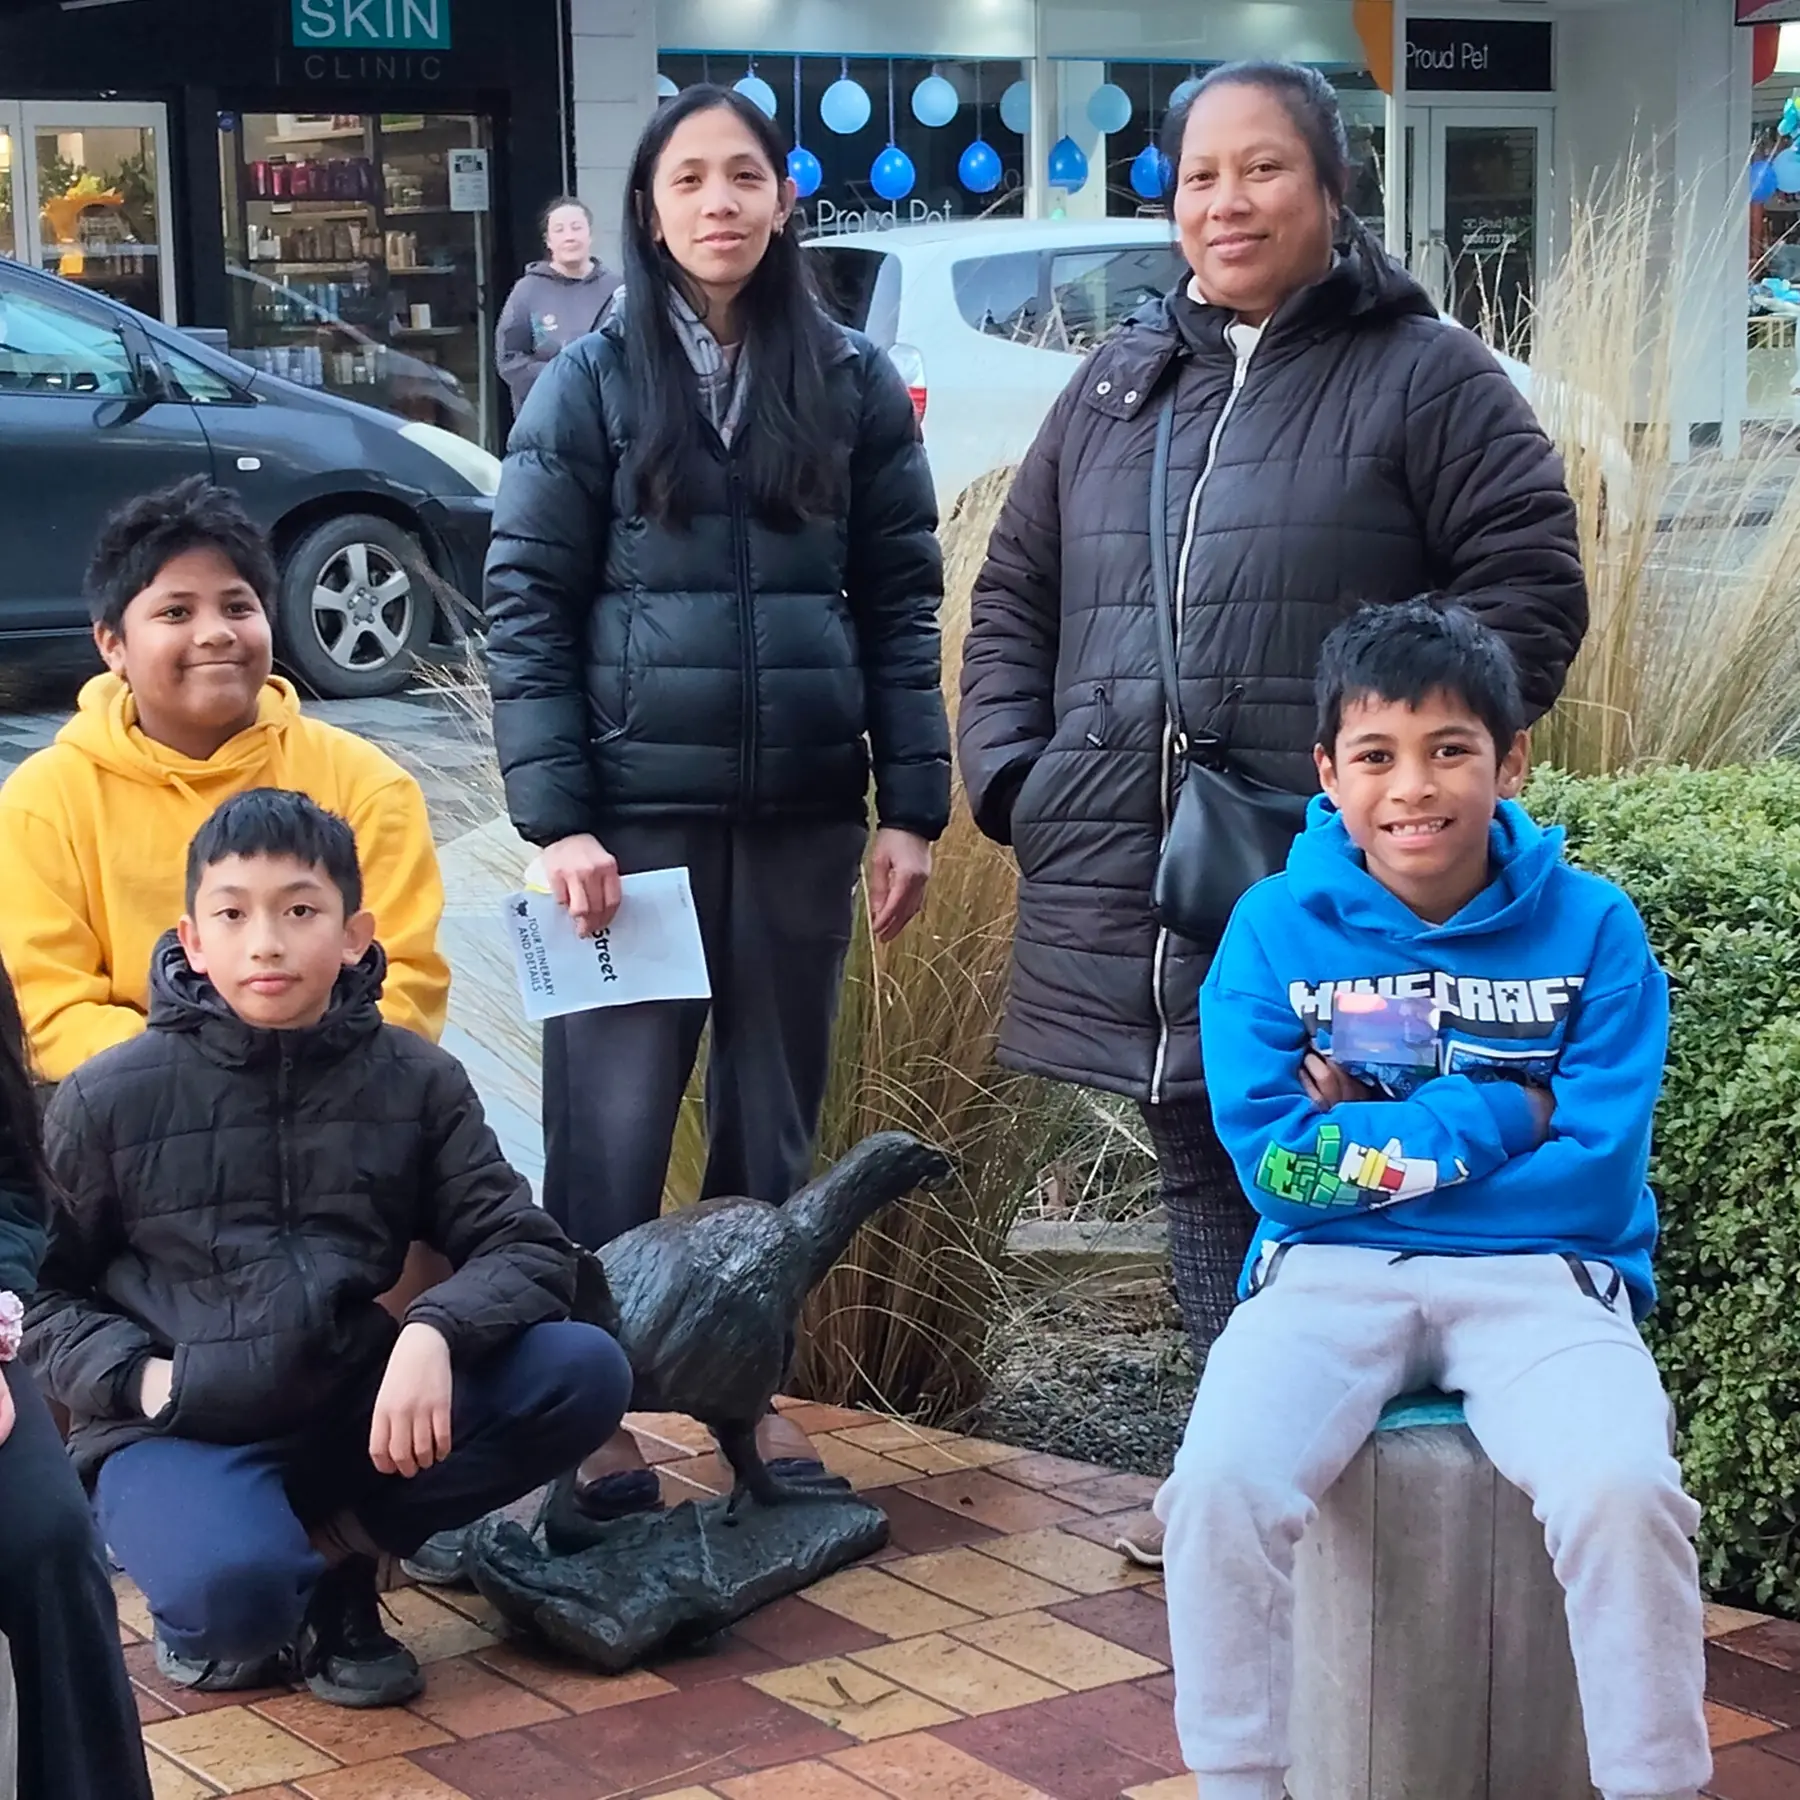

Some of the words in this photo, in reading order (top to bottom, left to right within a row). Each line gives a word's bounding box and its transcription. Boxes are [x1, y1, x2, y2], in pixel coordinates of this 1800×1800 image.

[301, 0, 439, 39] SKIN
[304, 54, 441, 80] CLINIC
[1406, 41, 1454, 69] Proud
[1462, 43, 1488, 70] Pet
[817, 199, 897, 238] Proud
[518, 927, 532, 951] AND
[525, 952, 544, 992] DETAILS
[528, 917, 543, 947] TOUR
[536, 945, 556, 996] ITINERARY
[592, 927, 618, 982] Street
